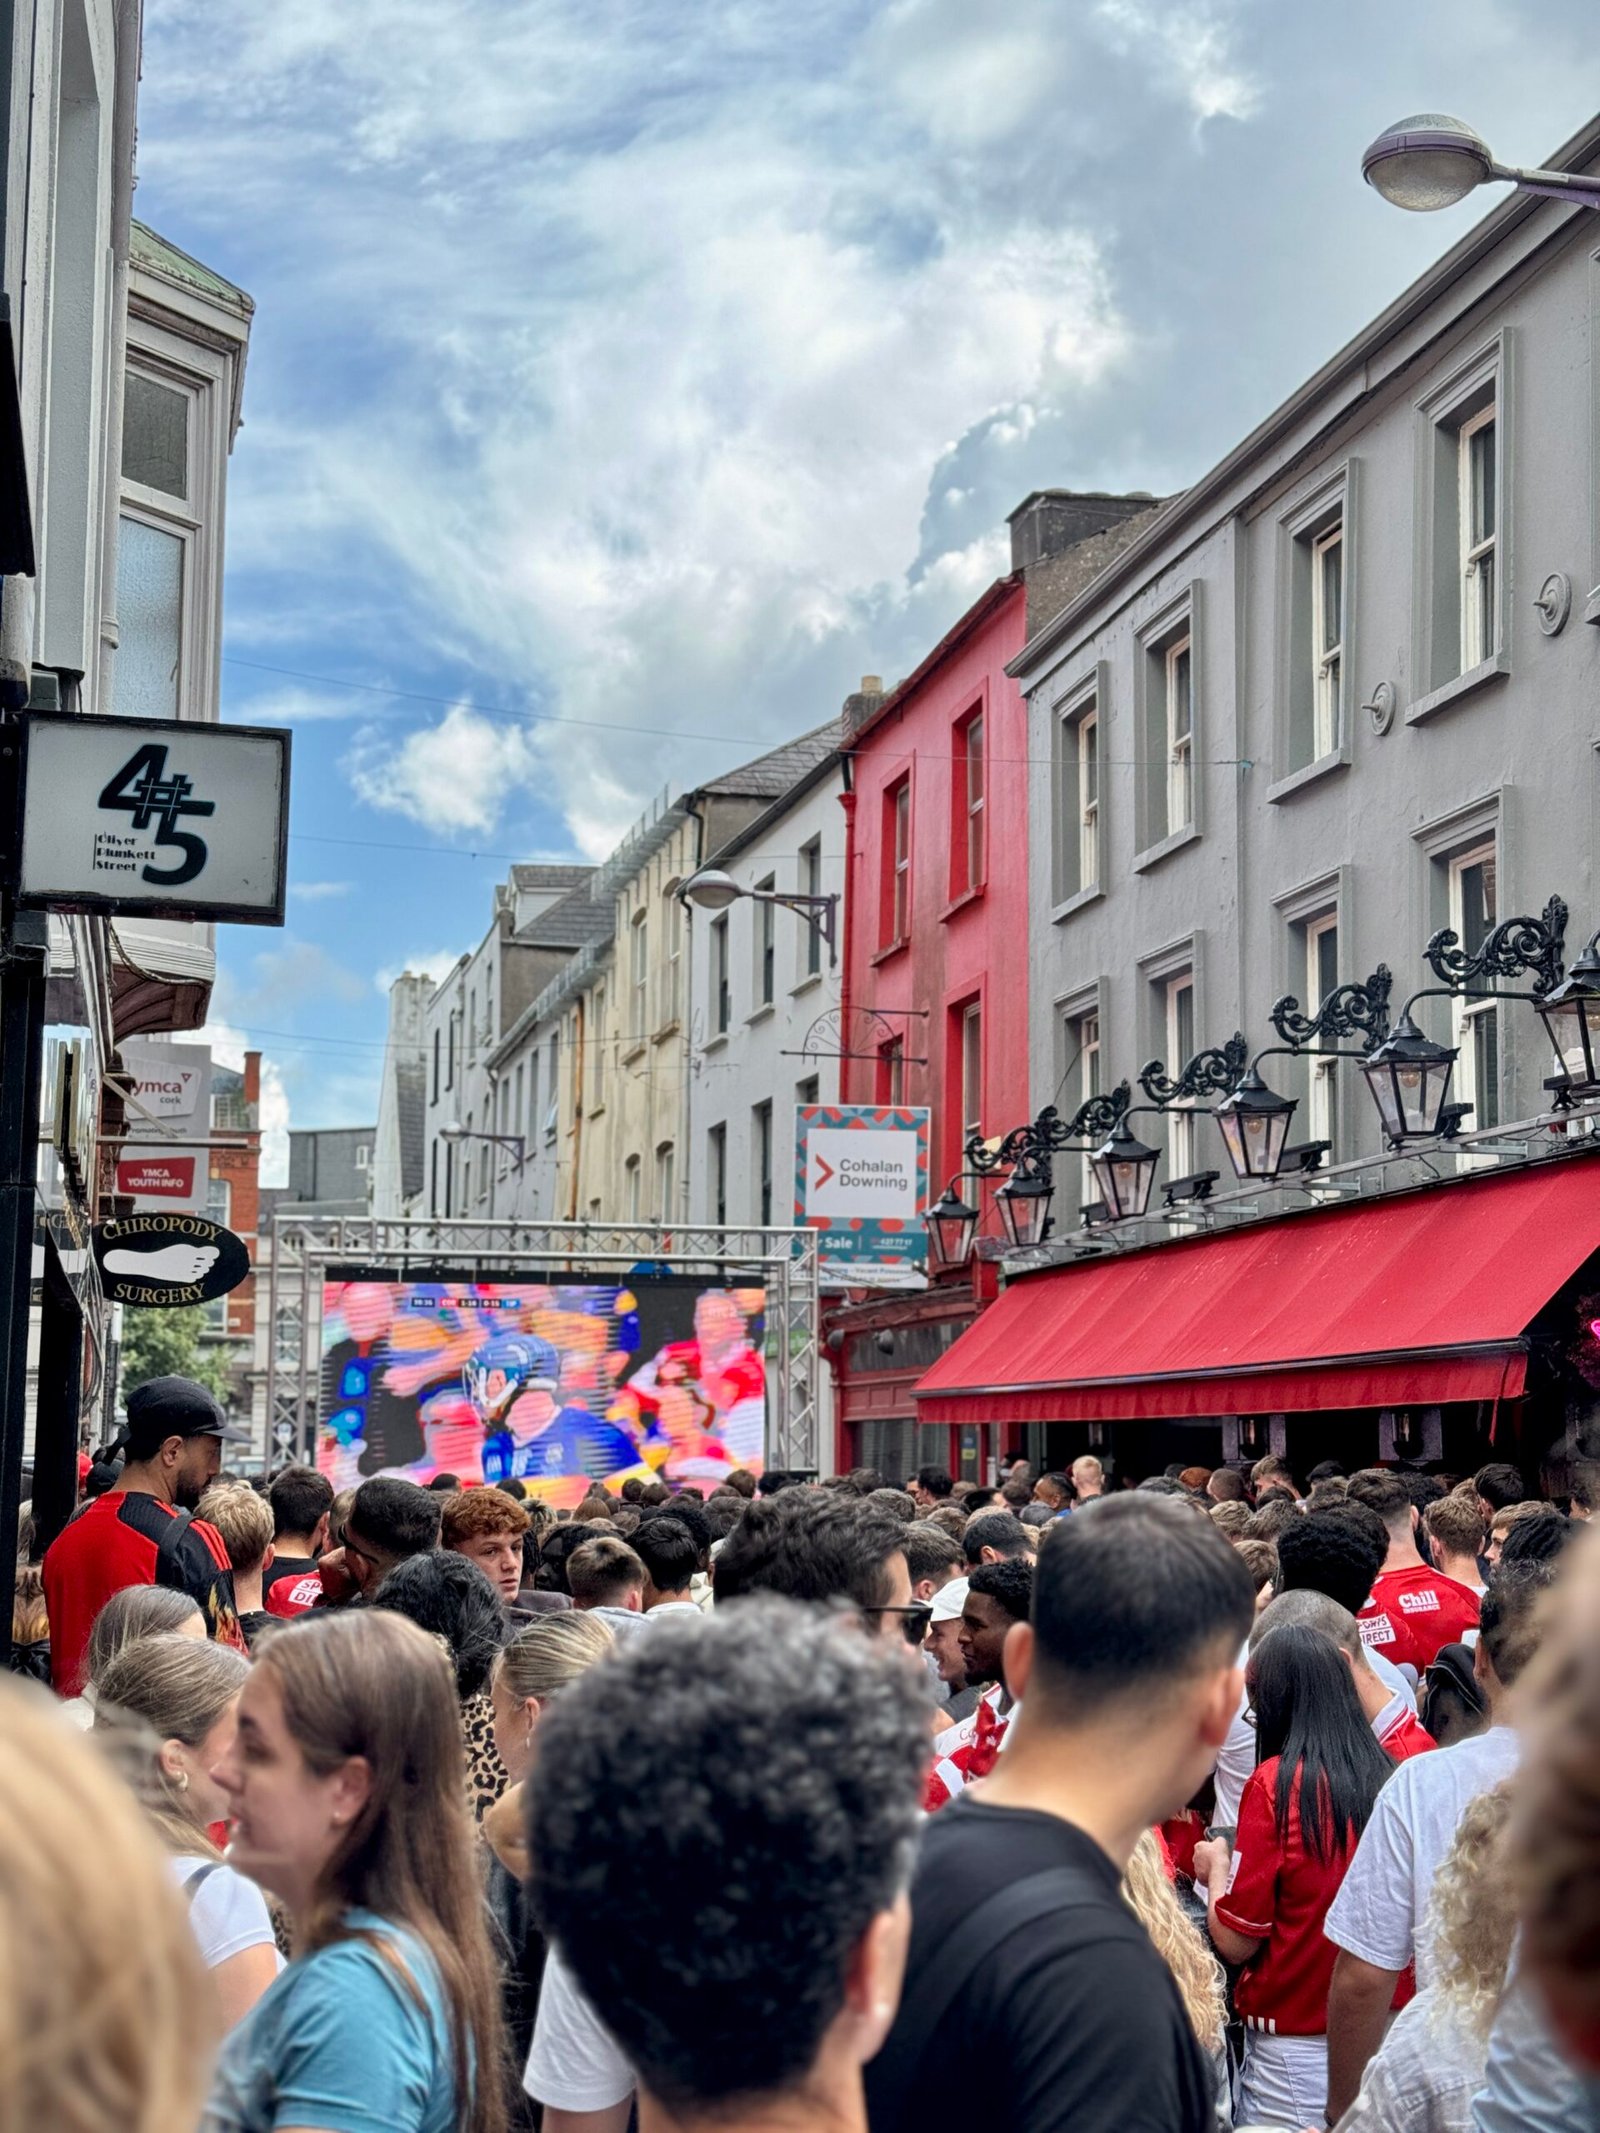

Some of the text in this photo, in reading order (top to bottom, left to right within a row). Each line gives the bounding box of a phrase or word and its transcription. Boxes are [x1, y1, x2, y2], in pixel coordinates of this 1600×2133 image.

[97, 847, 156, 860] Plunkett
[96, 860, 137, 872] Street
[133, 1081, 182, 1097] ymca
[160, 1096, 182, 1105] cork
[142, 1168, 170, 1178] YMCA
[840, 1159, 903, 1173] Cohalan
[127, 1178, 184, 1188] YOUTH INFO
[840, 1174, 908, 1191] Downing
[102, 1216, 222, 1241] CHIROPODY
[825, 1237, 853, 1249] Sale
[114, 1282, 205, 1304] SURGERY
[1398, 1590, 1438, 1608] Chill
[1362, 1630, 1391, 1645] IRECT
